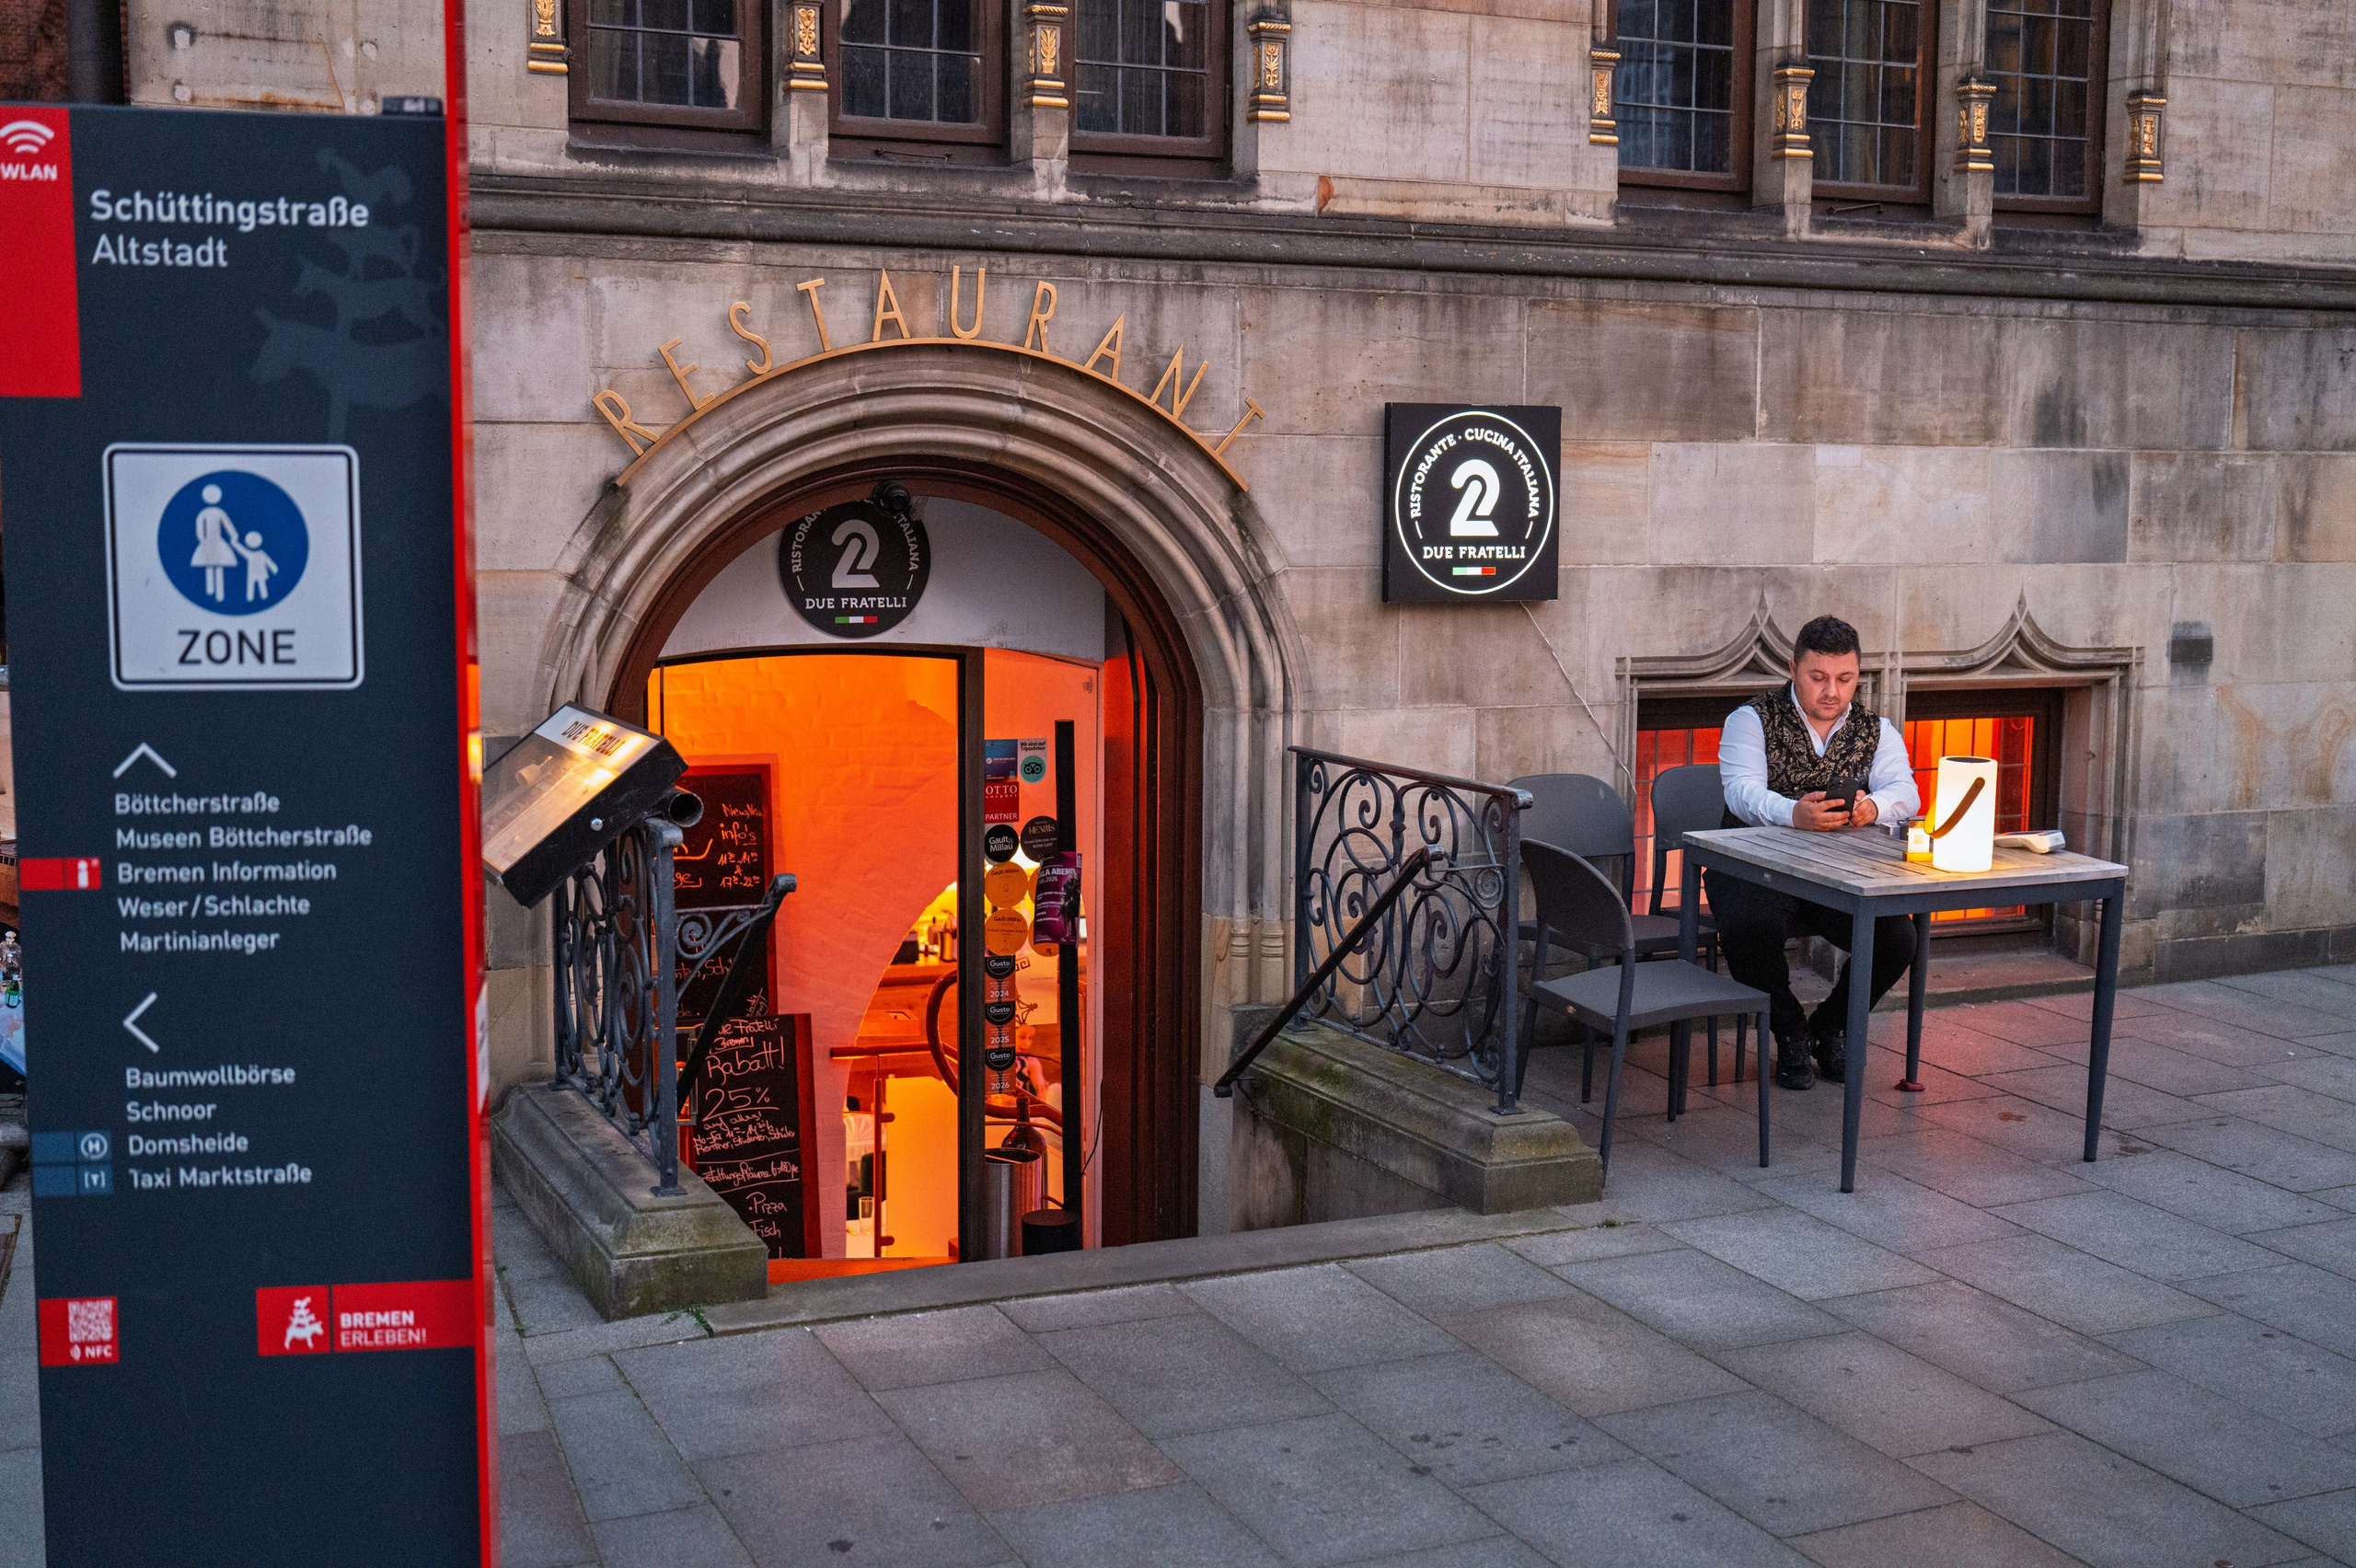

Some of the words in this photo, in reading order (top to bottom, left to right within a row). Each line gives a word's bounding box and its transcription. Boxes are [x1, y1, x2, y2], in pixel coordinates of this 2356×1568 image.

[0, 163, 58, 181] WLAN
[90, 189, 370, 232] Schüttingstraße
[92, 234, 228, 268] Altstadt
[592, 265, 1266, 457] RESTAURANT
[1410, 434, 1456, 519] RISTORANTE
[1464, 428, 1516, 455] CUCINA
[1512, 449, 1540, 519] ITALIANA
[1449, 458, 1500, 536] 2
[791, 508, 827, 573] RISTORAN
[1423, 546, 1453, 559] DUE
[1459, 546, 1526, 559] FRATELLI
[831, 519, 881, 589] 2
[805, 597, 835, 610] DUE
[841, 596, 907, 609] FRATELLI
[178, 628, 297, 665] ZONE
[561, 721, 589, 741] DUE
[578, 727, 627, 757] FRATELLI
[986, 785, 1018, 795] OTTO
[114, 791, 281, 815] Böttcherstraße
[985, 813, 1018, 821] PARTNER
[116, 828, 202, 848] Museen
[210, 824, 373, 847] Böttcherstraße
[1028, 824, 1056, 835] HENRIS
[989, 844, 1013, 852] Millau
[117, 862, 204, 884] Bremen
[213, 860, 337, 883] Information
[121, 930, 281, 955] Martinianleger
[730, 1018, 780, 1034] Fratelli
[713, 1036, 749, 1051] Bremen
[990, 1035, 1010, 1043] 2025
[705, 1035, 785, 1086] Rabatt!
[125, 1065, 296, 1089] Baumwollbörse
[990, 1081, 1010, 1090] 2026
[126, 1101, 217, 1123] Schnoor
[702, 1087, 770, 1122] 25%
[129, 1133, 249, 1157] Domsheide
[129, 1168, 172, 1190] Taxi
[179, 1163, 313, 1187] Marktstraße
[746, 1191, 788, 1215] Pizza
[749, 1218, 781, 1239] Fisch
[341, 1309, 415, 1329] BREMEN
[341, 1326, 427, 1346] ERLEBEN!
[85, 1344, 113, 1360] NFC
